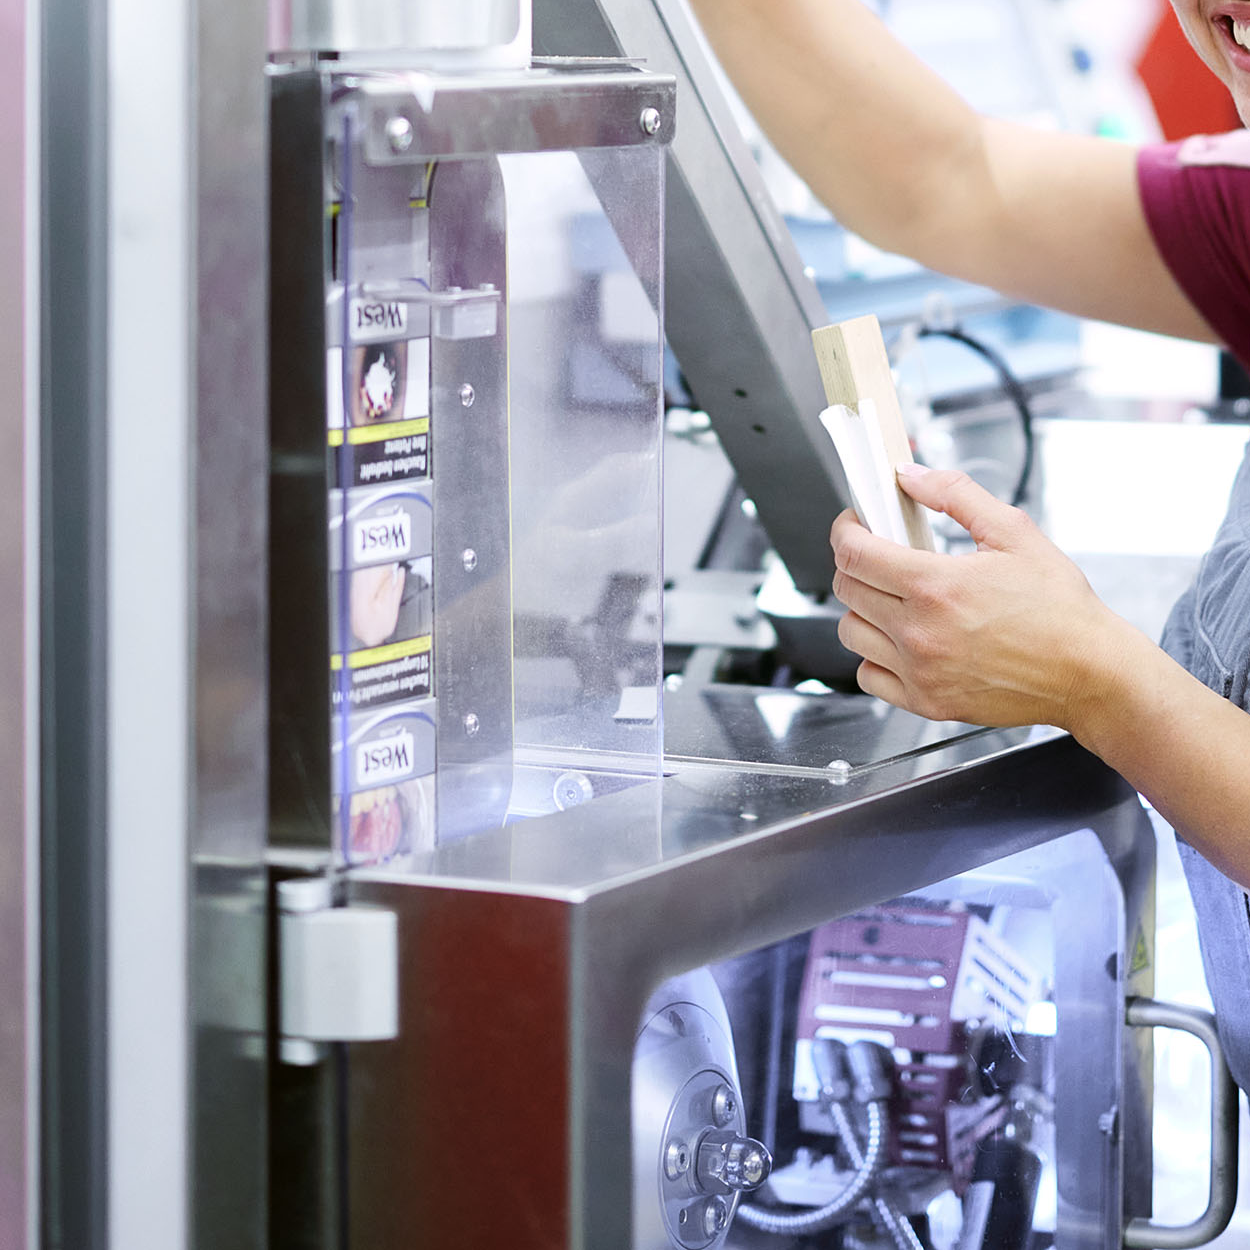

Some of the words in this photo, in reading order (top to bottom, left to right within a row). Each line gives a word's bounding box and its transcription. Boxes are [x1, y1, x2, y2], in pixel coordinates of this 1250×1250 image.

[356, 301, 402, 329] West
[361, 523, 406, 551] West
[363, 742, 409, 773] West
